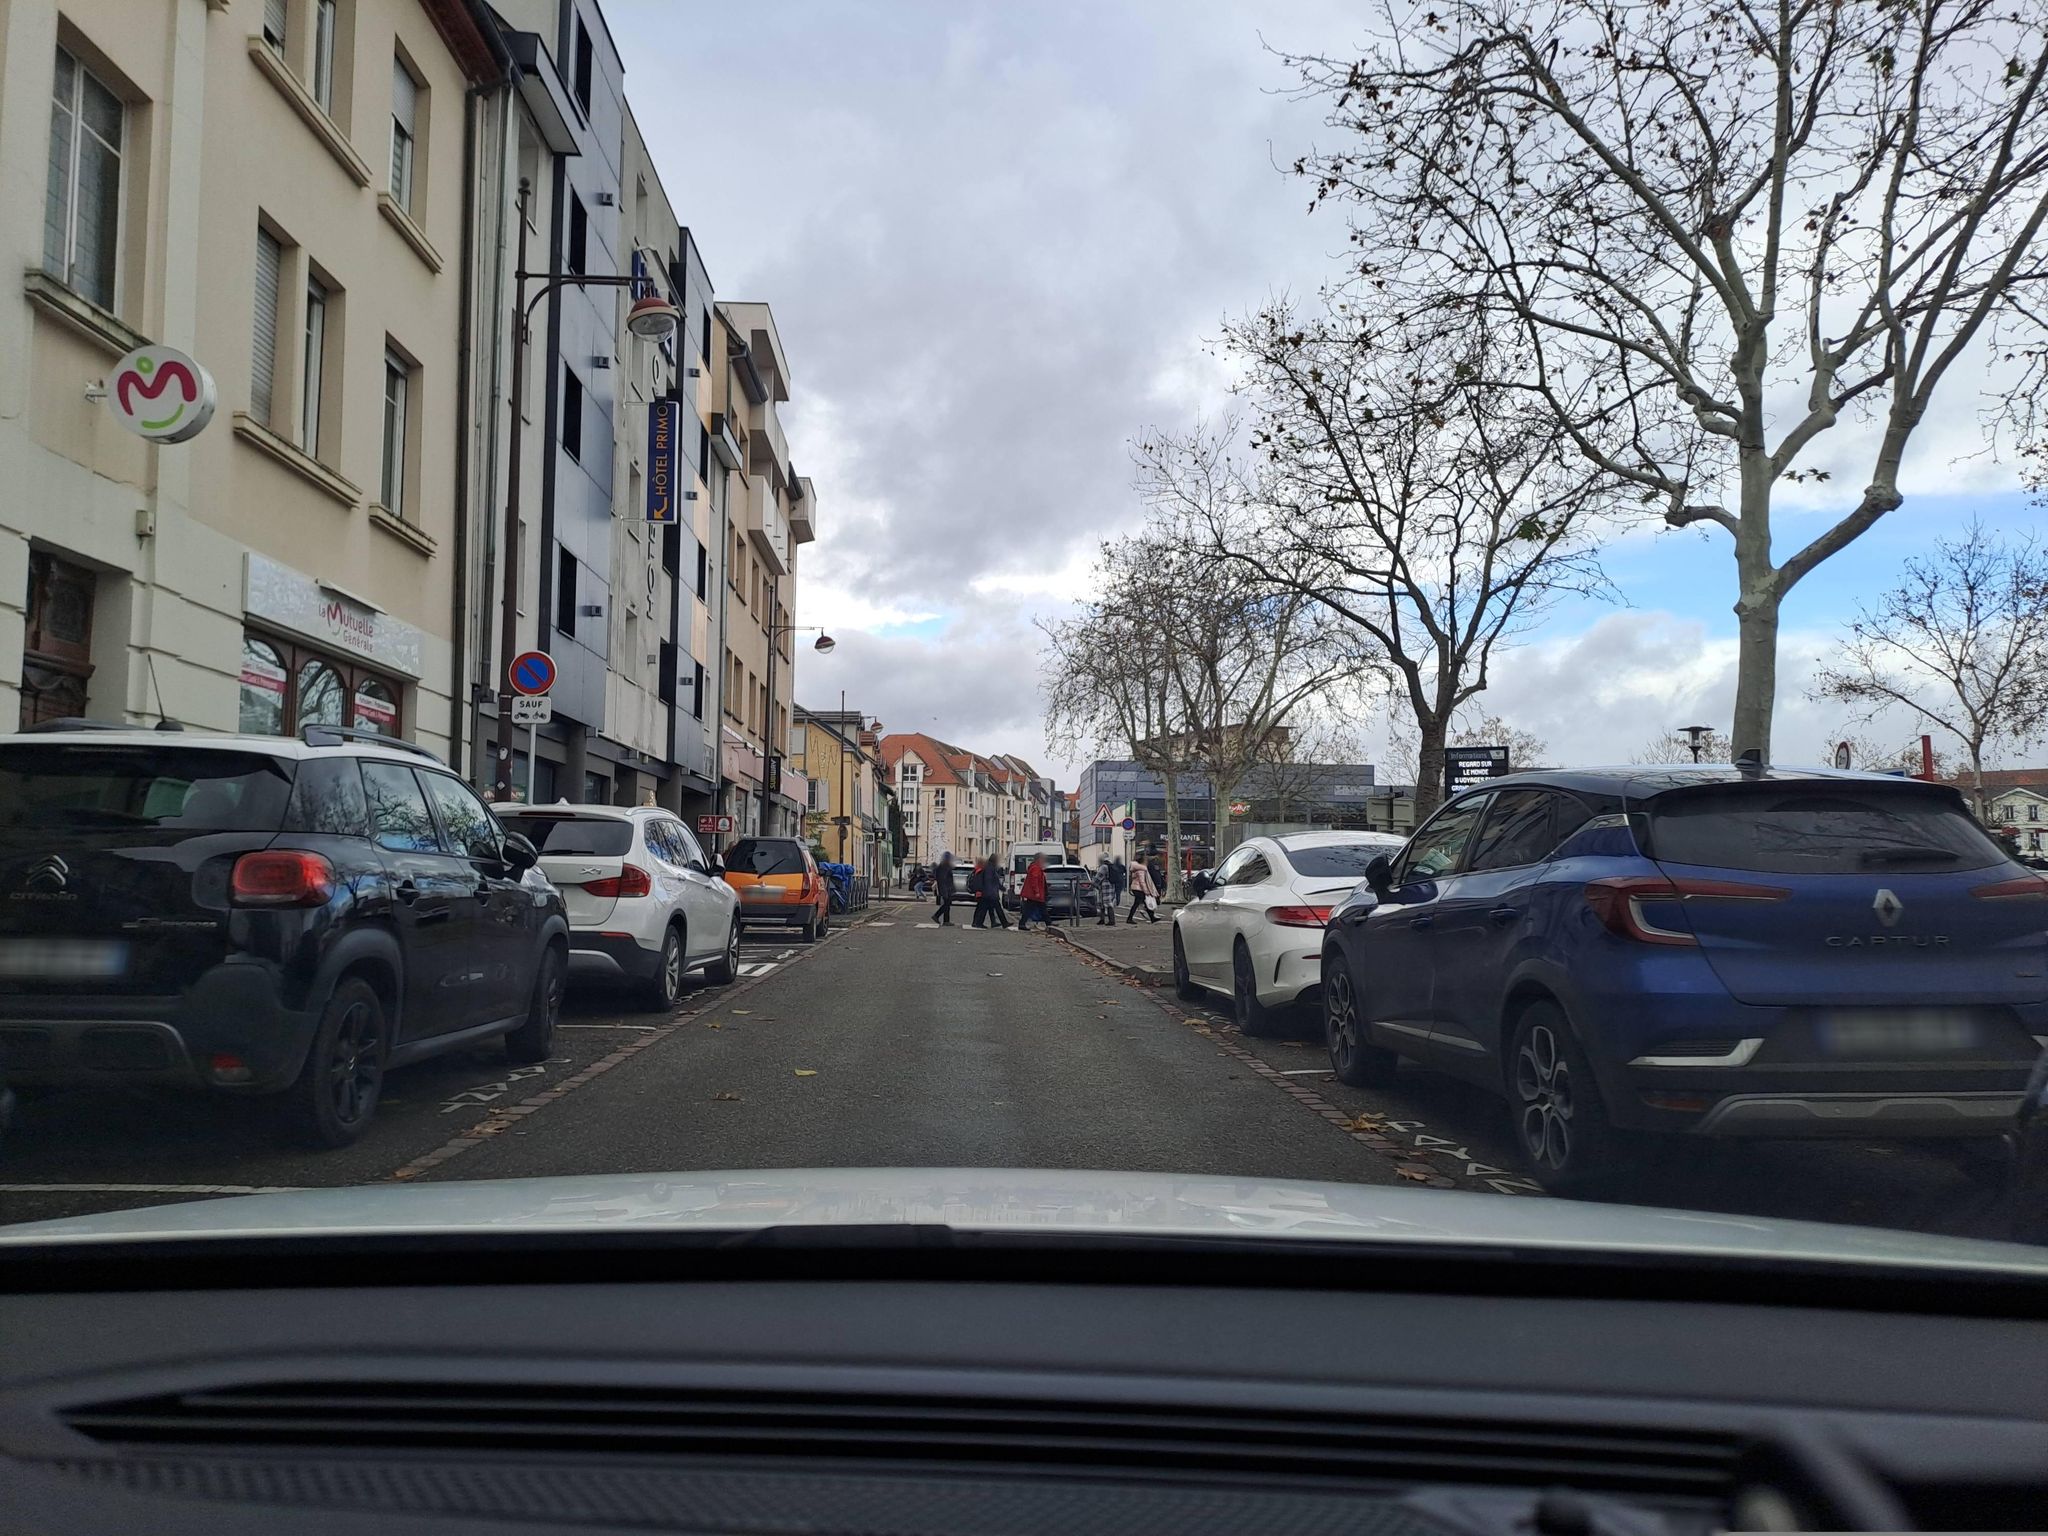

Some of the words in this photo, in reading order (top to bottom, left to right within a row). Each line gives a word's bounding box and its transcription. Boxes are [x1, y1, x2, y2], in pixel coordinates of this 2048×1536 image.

[656, 405, 669, 449] PRIMO
[652, 453, 668, 496] HÔTEL
[327, 602, 374, 638] Mutuelle
[519, 700, 543, 708] SAUF
[1824, 935, 1950, 947] CAPTUR
